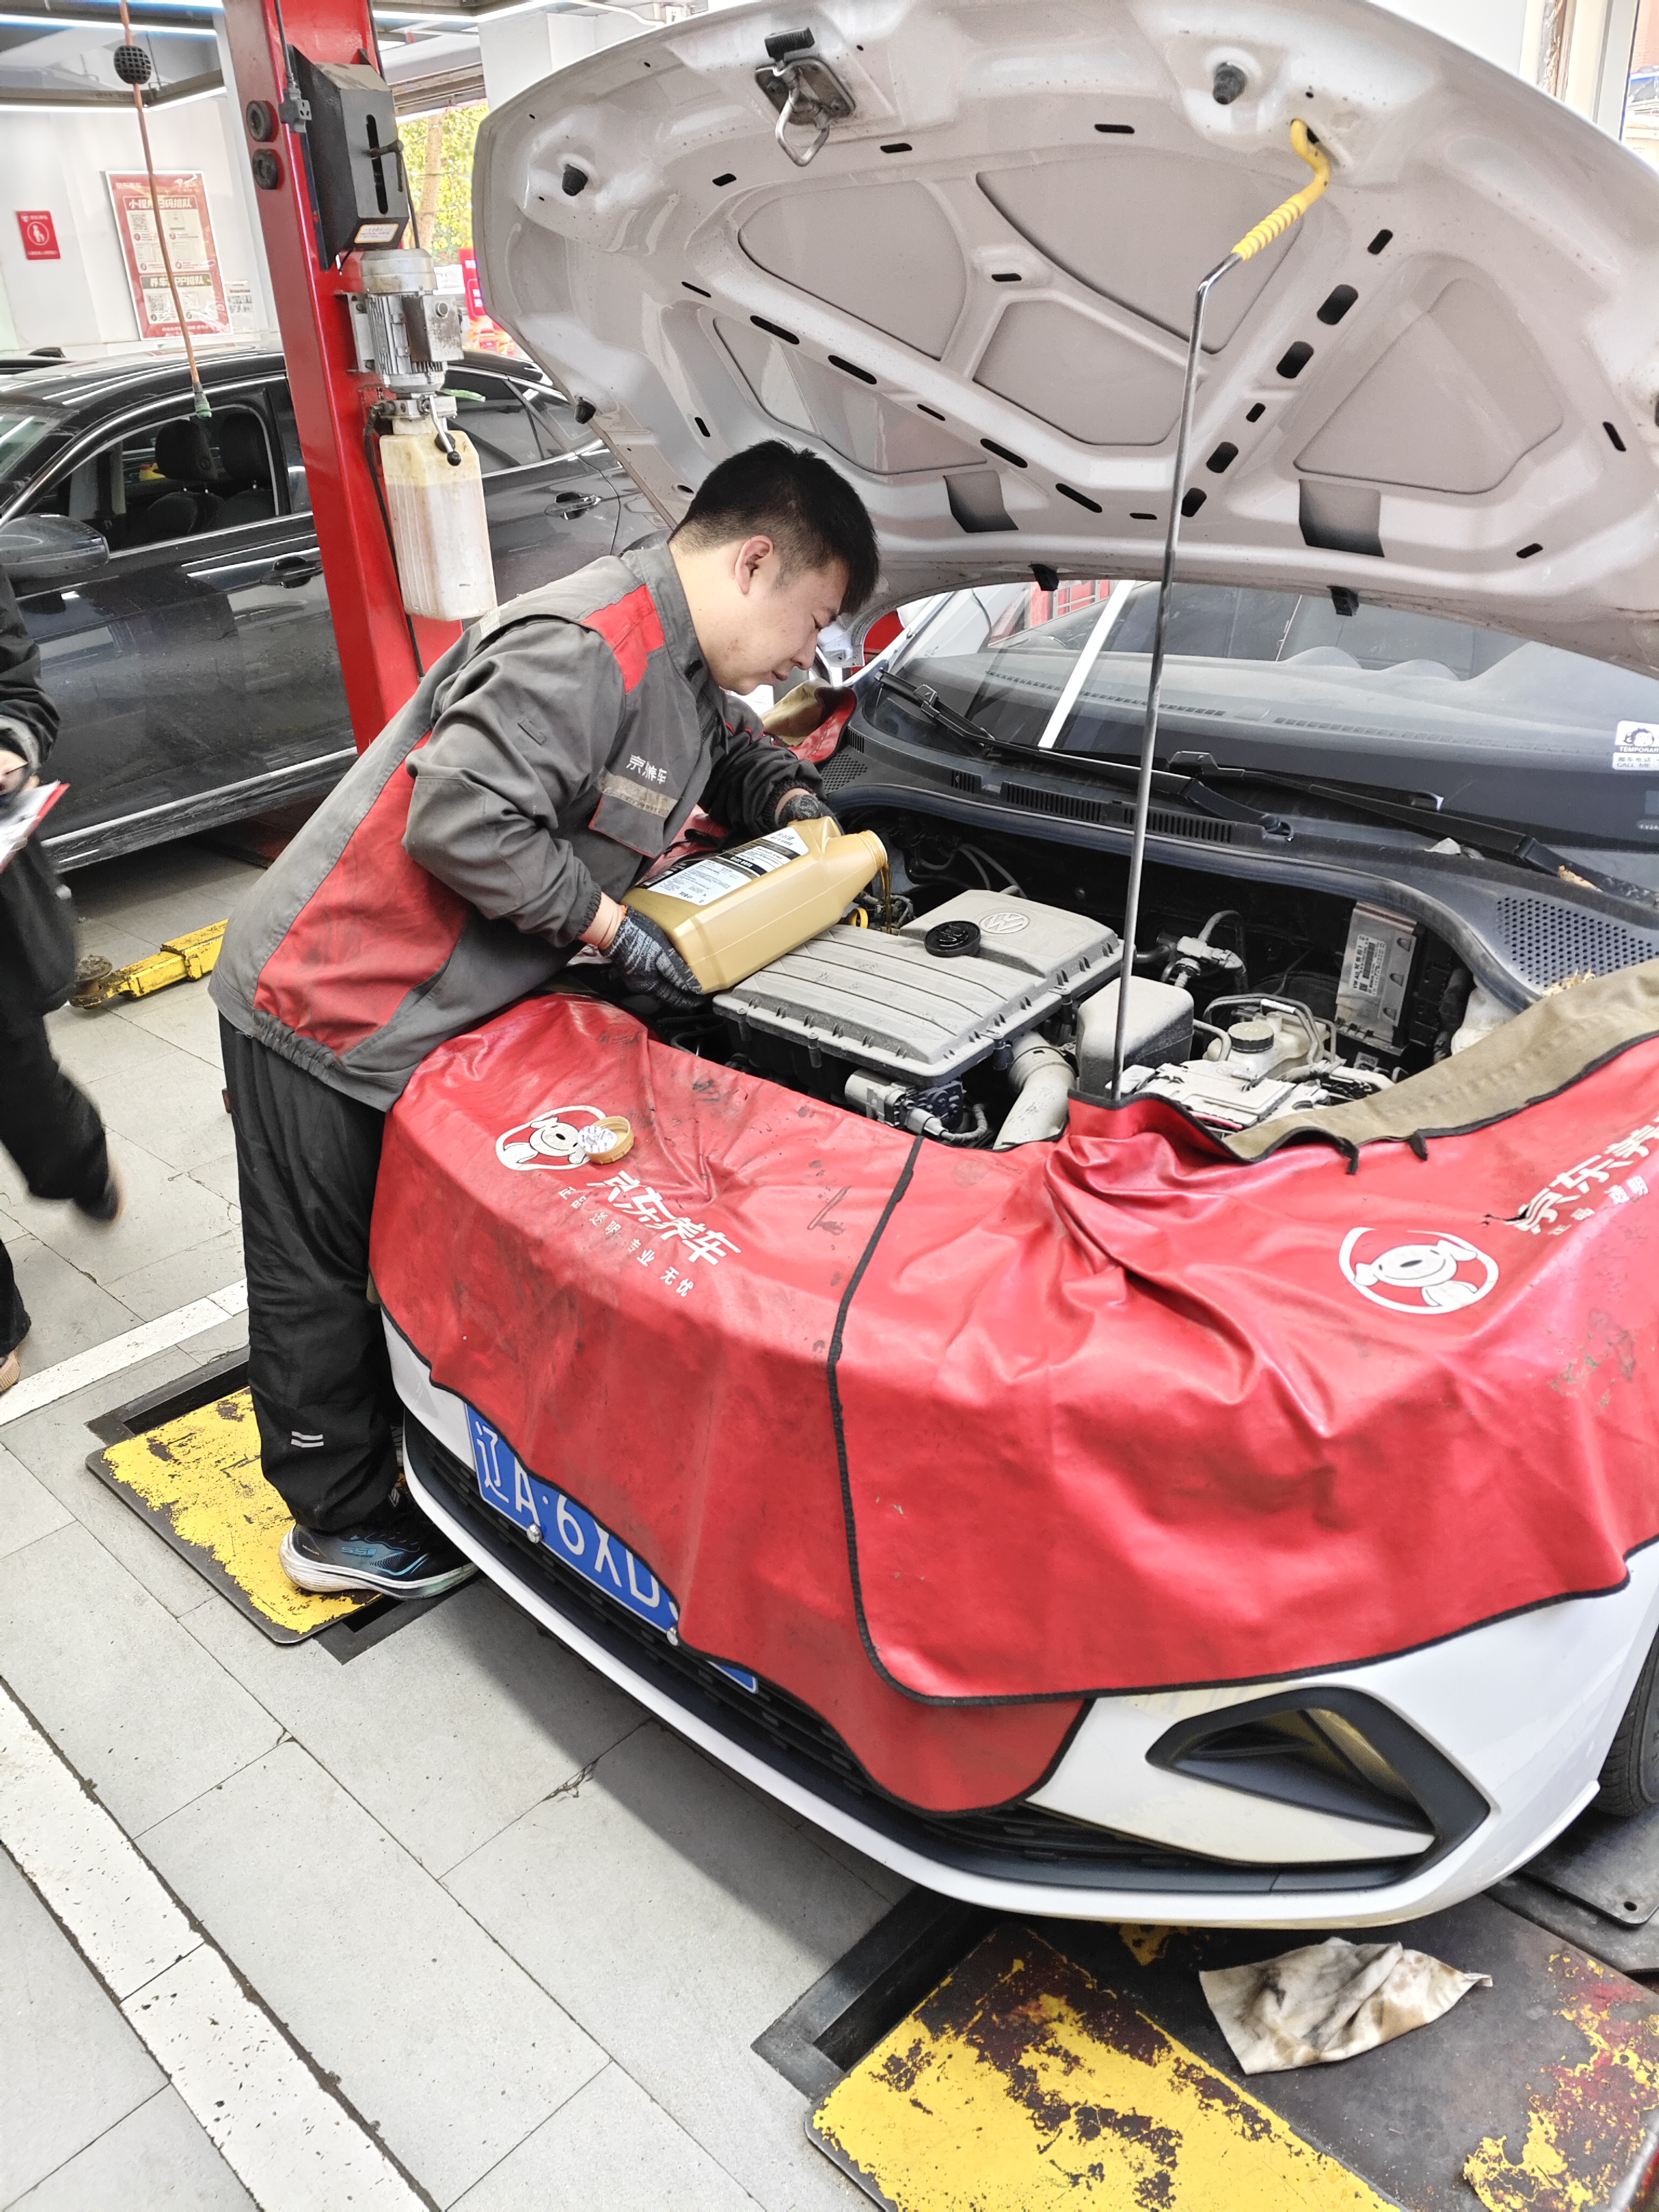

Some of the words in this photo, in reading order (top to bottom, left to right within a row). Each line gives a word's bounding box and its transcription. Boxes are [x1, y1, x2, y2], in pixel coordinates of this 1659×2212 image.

[150, 275, 205, 287] 养车PP排队
[1504, 1114, 1659, 1235] 京东养
[660, 1266, 694, 1297] 无忧
[475, 1421, 678, 1621] 辽A·6XD
